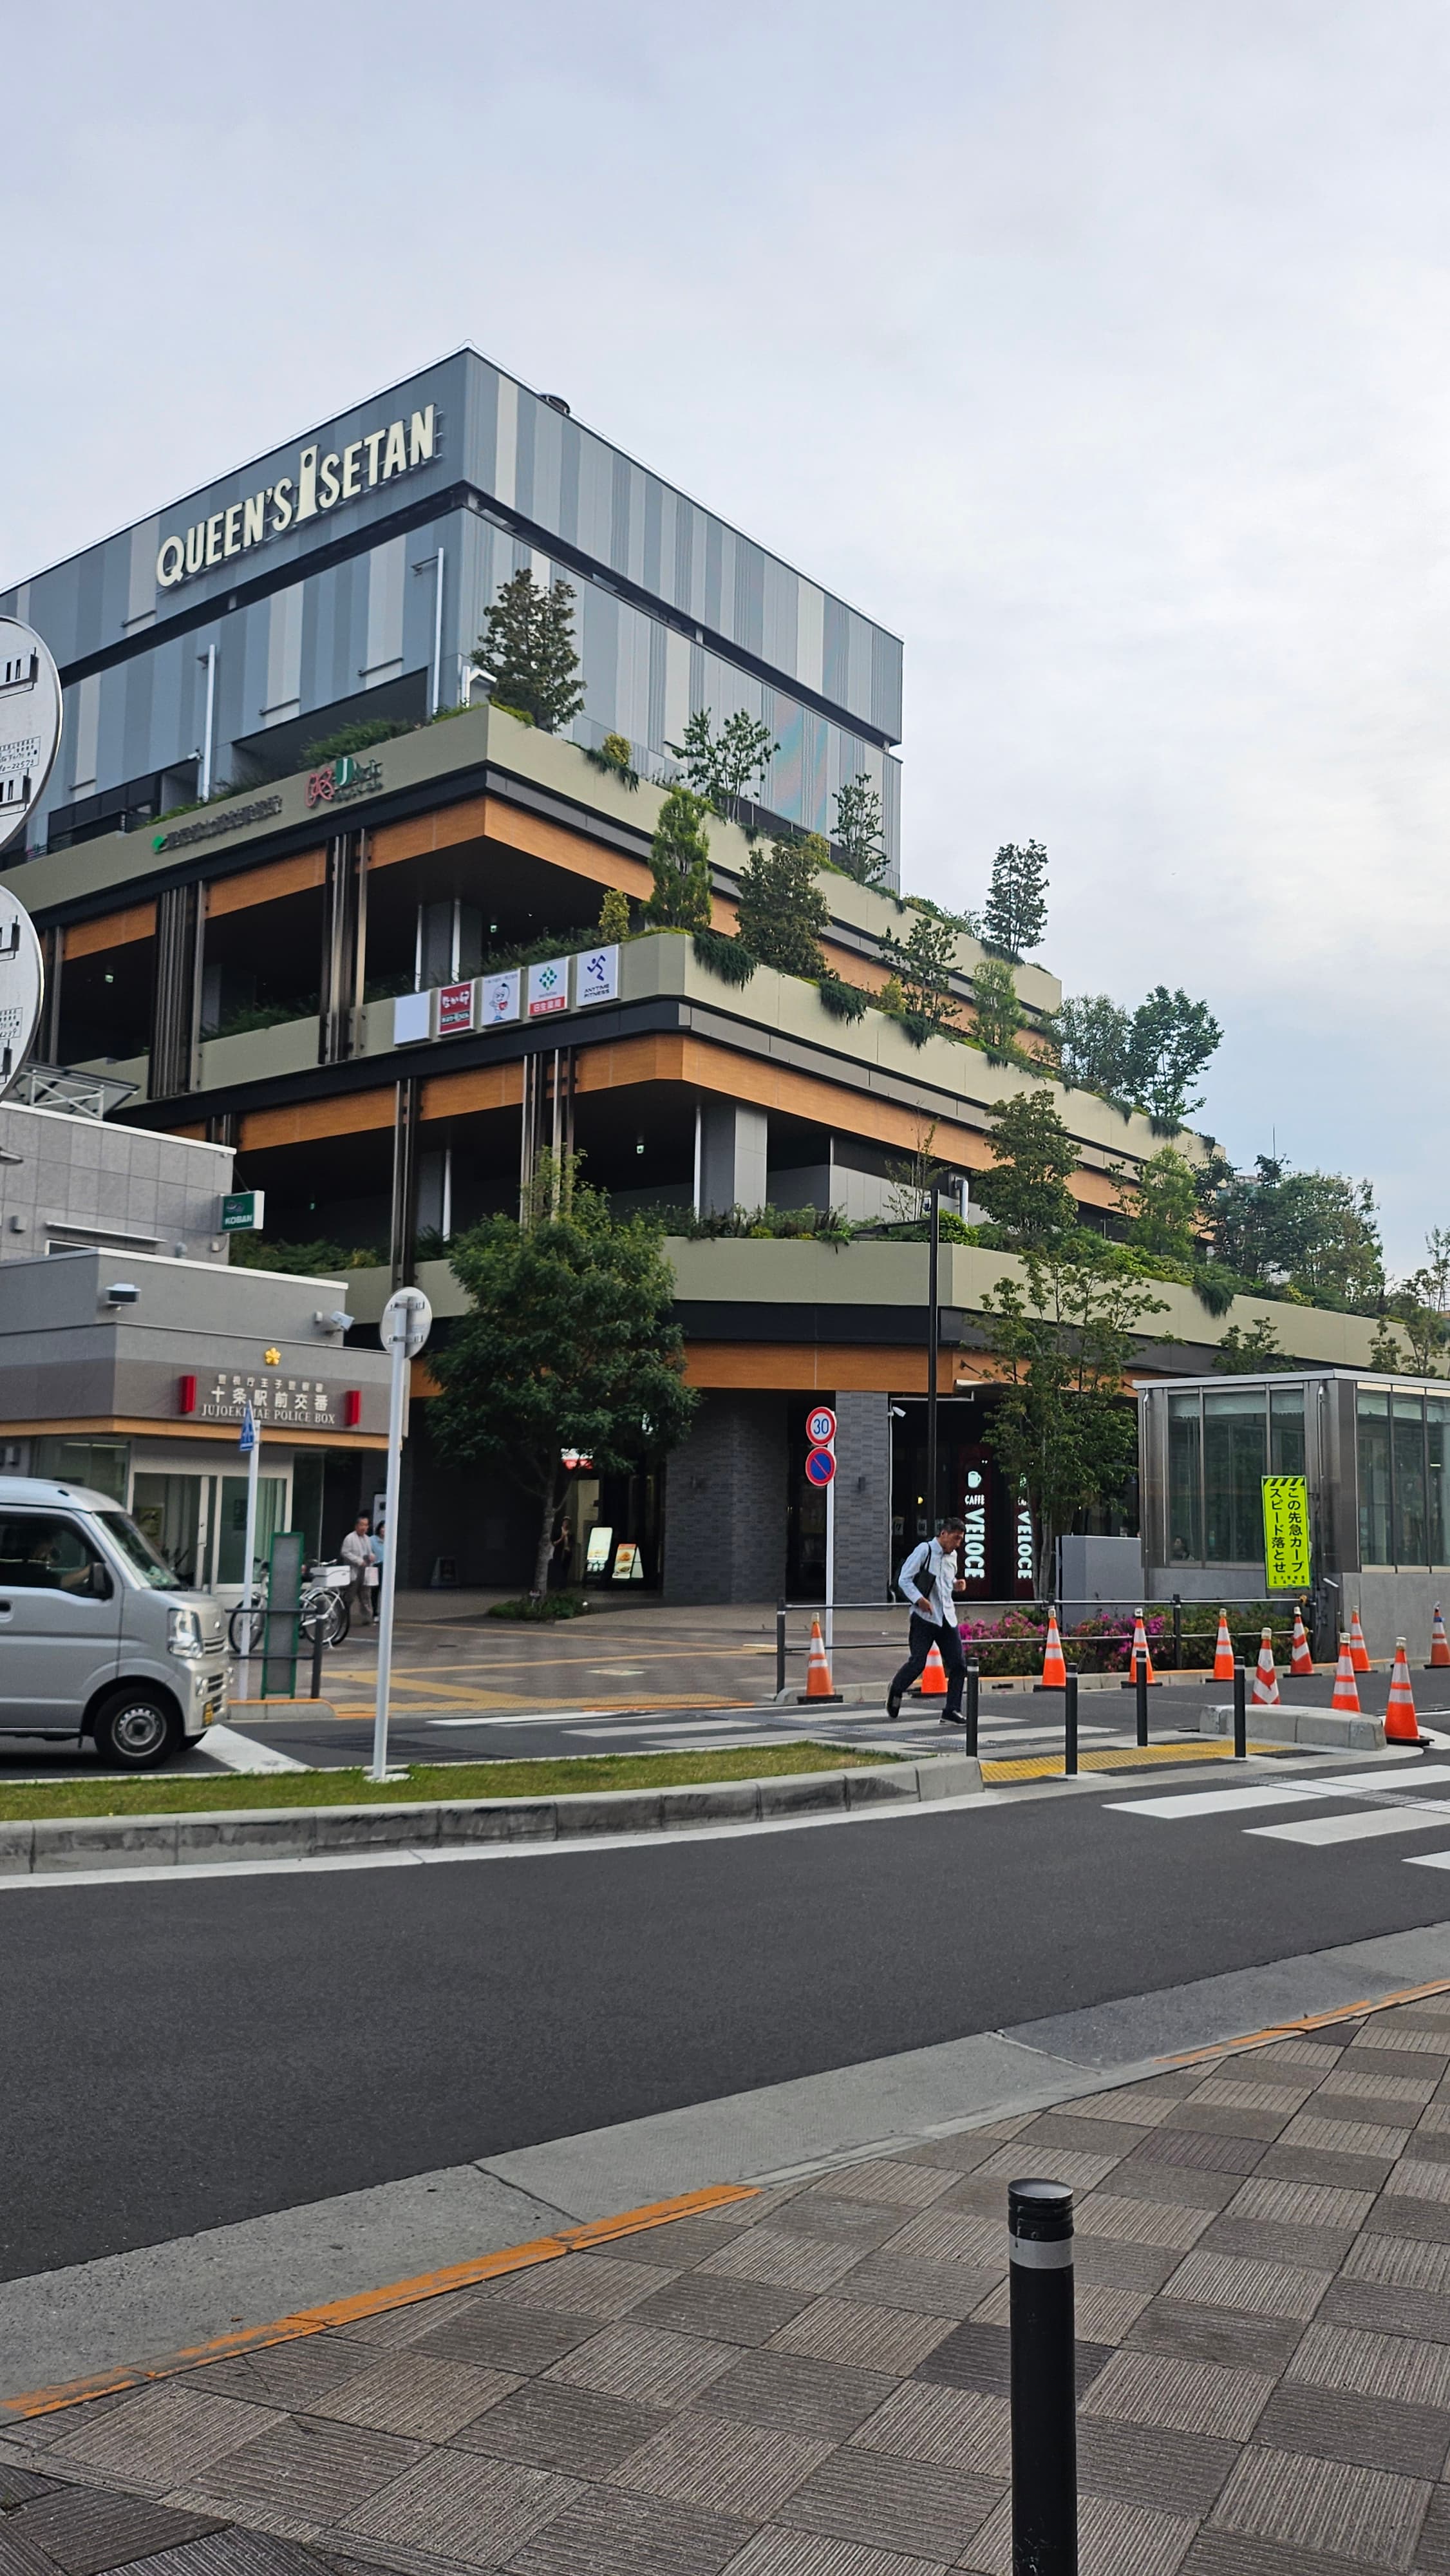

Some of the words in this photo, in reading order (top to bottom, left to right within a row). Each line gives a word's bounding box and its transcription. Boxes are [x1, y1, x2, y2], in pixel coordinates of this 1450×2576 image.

[156, 477, 292, 587] QUEEN'S
[295, 403, 436, 523] ISETAN
[584, 989, 609, 998] FITNESS
[585, 983, 609, 993] ANYTIME
[225, 1215, 252, 1225] KOBAN
[211, 1386, 328, 1412] 十条駅前交番
[274, 1410, 311, 1423] POLICE
[314, 1414, 335, 1425] BOX
[813, 1418, 829, 1435] 30
[1270, 1488, 1286, 1573] スピード落とせ
[1288, 1487, 1304, 1573] この先急カーブ
[965, 1508, 985, 1579] VELOCE
[1017, 1510, 1033, 1579] VELOCE
